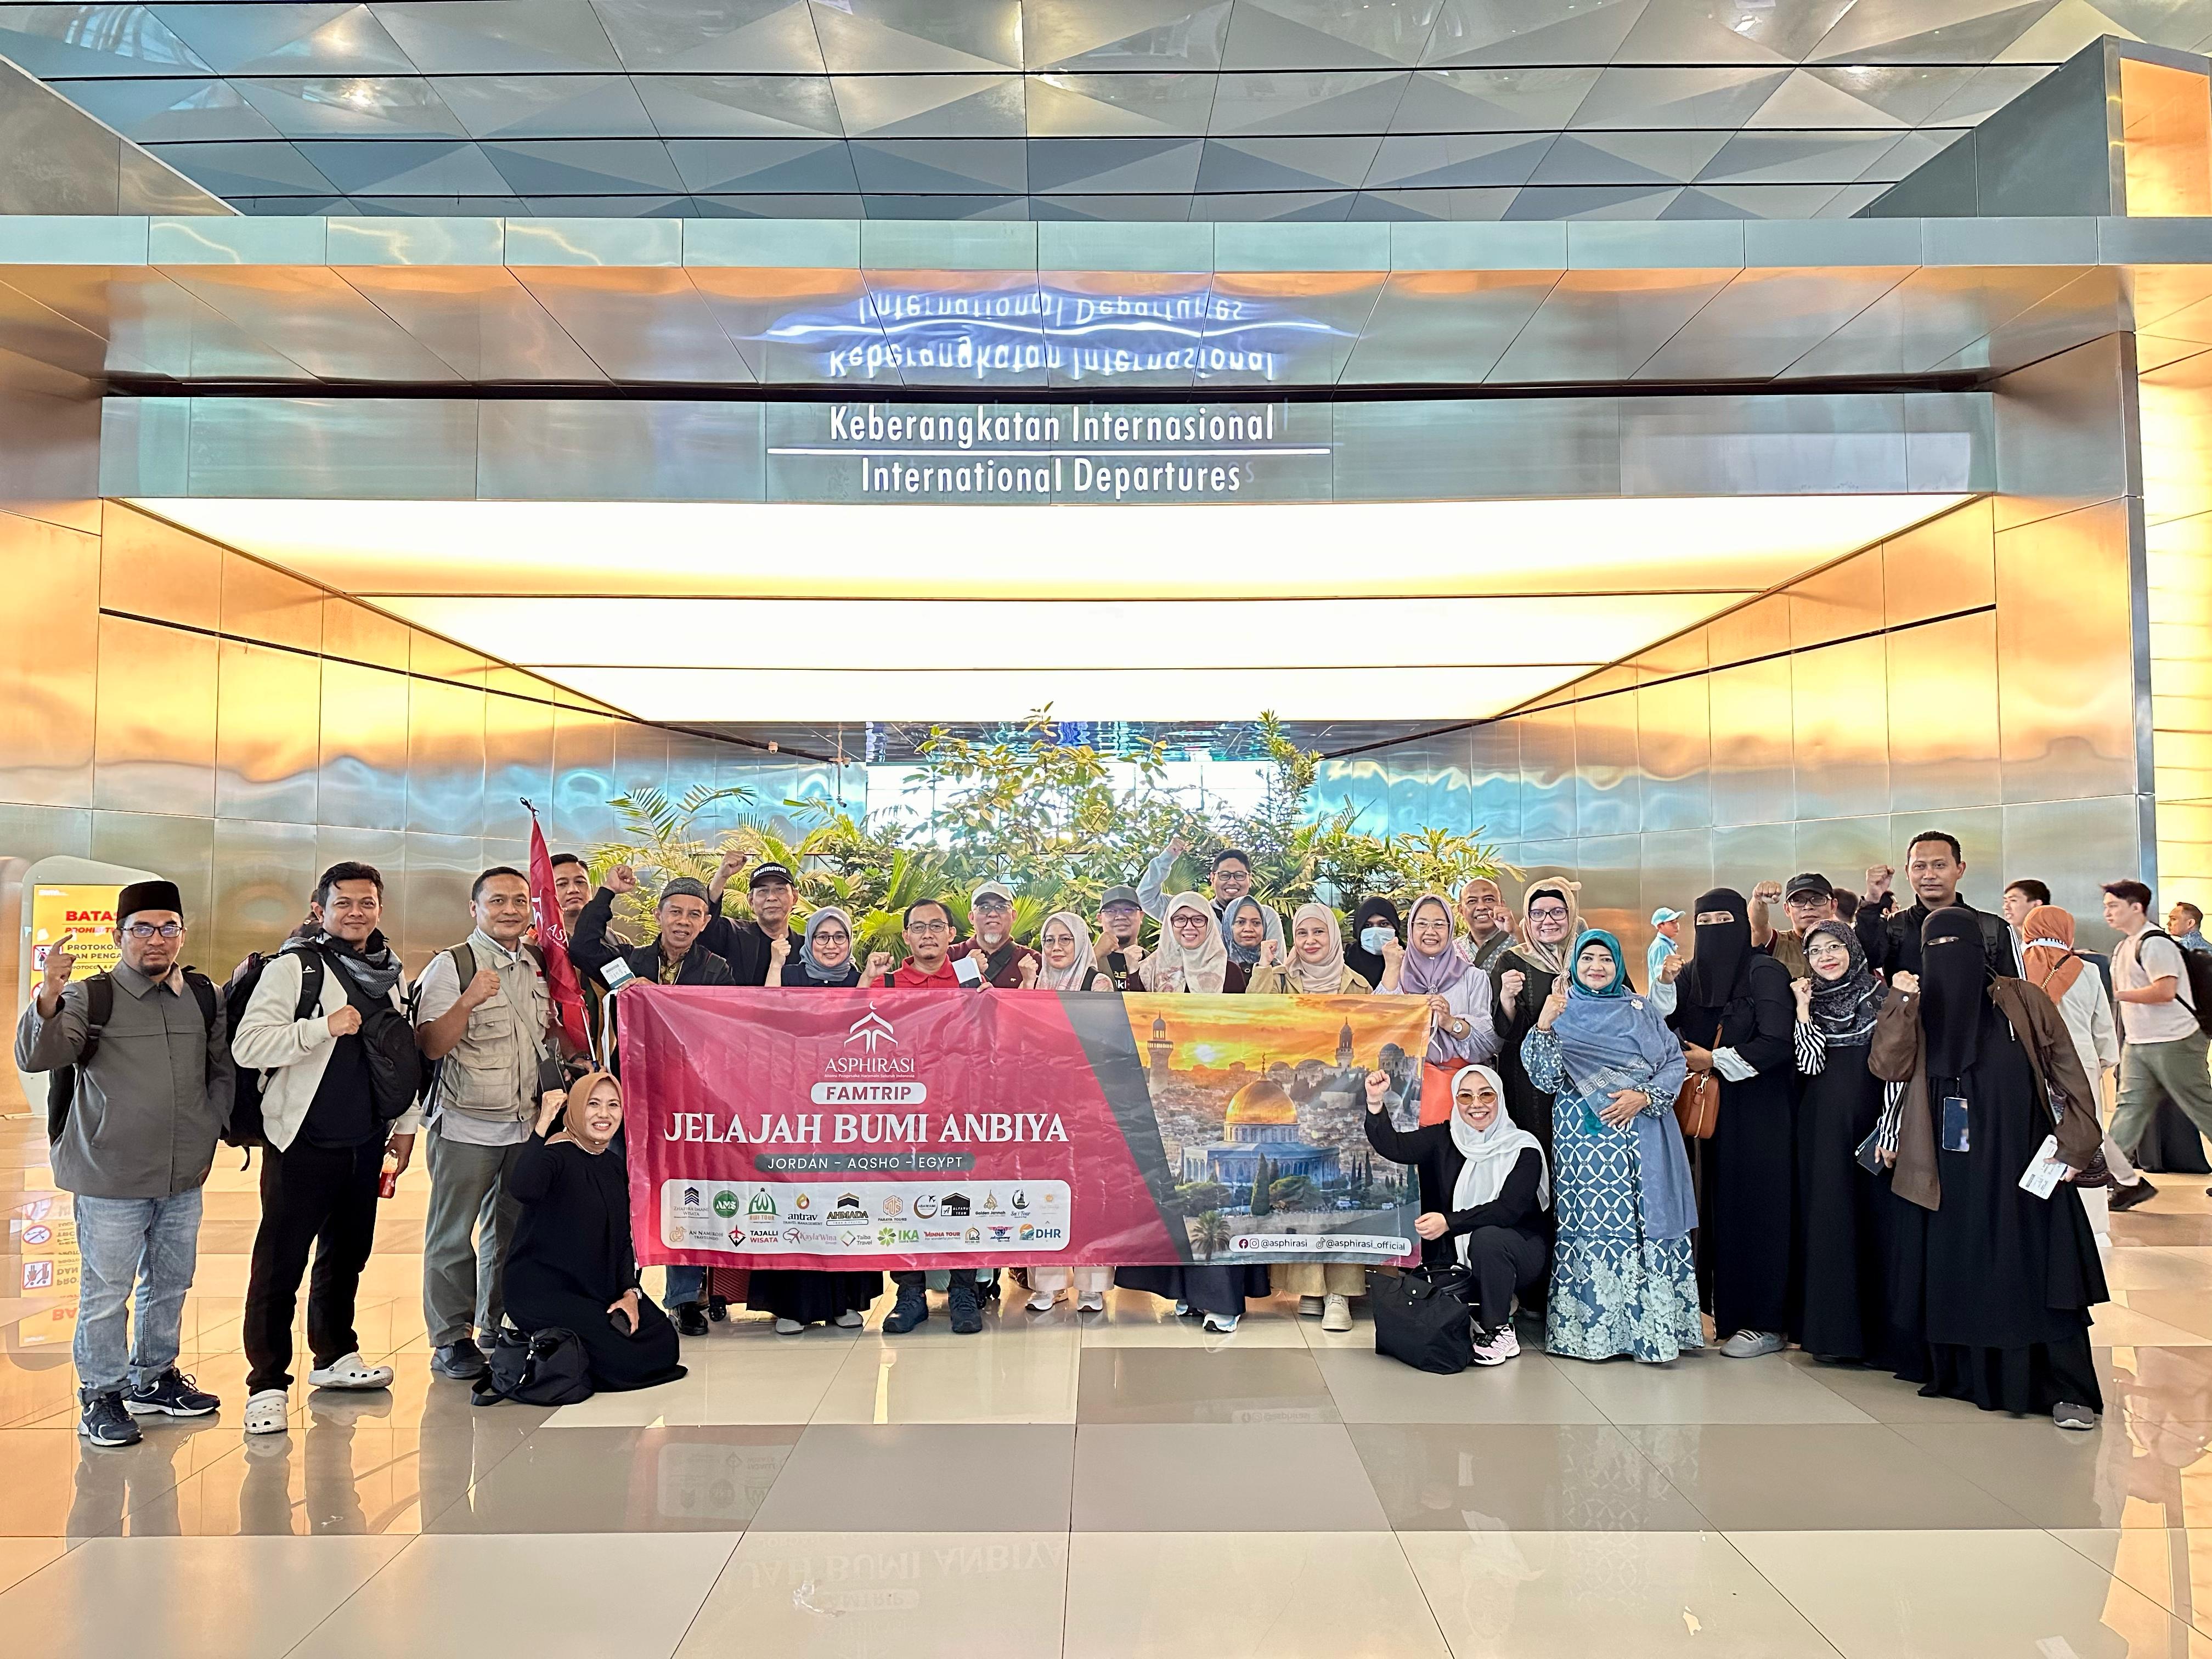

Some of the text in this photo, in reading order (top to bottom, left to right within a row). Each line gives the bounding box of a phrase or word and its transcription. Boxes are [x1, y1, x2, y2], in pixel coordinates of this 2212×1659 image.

[830, 404, 1274, 449] Keberangkatan Internasional
[862, 457, 1241, 500] International Departures
[753, 866, 787, 878] SHIMANO
[825, 1058, 915, 1073] ASPHIRASI
[826, 1086, 911, 1100] FAMTRIP
[664, 1113, 1069, 1144] JELAJAH BUMI ANBIYA
[768, 1158, 828, 1170] JORDAN
[847, 1157, 900, 1170] AQSHO
[918, 1156, 963, 1169] EGYPT
[788, 1212, 818, 1221] antrav
[827, 1211, 869, 1220] AHMADA
[899, 1230, 919, 1240] IKA
[1036, 1229, 1061, 1238] DHR
[1261, 1238, 1307, 1248] @asphirasi
[1326, 1238, 1406, 1251] @asphirasi_official
